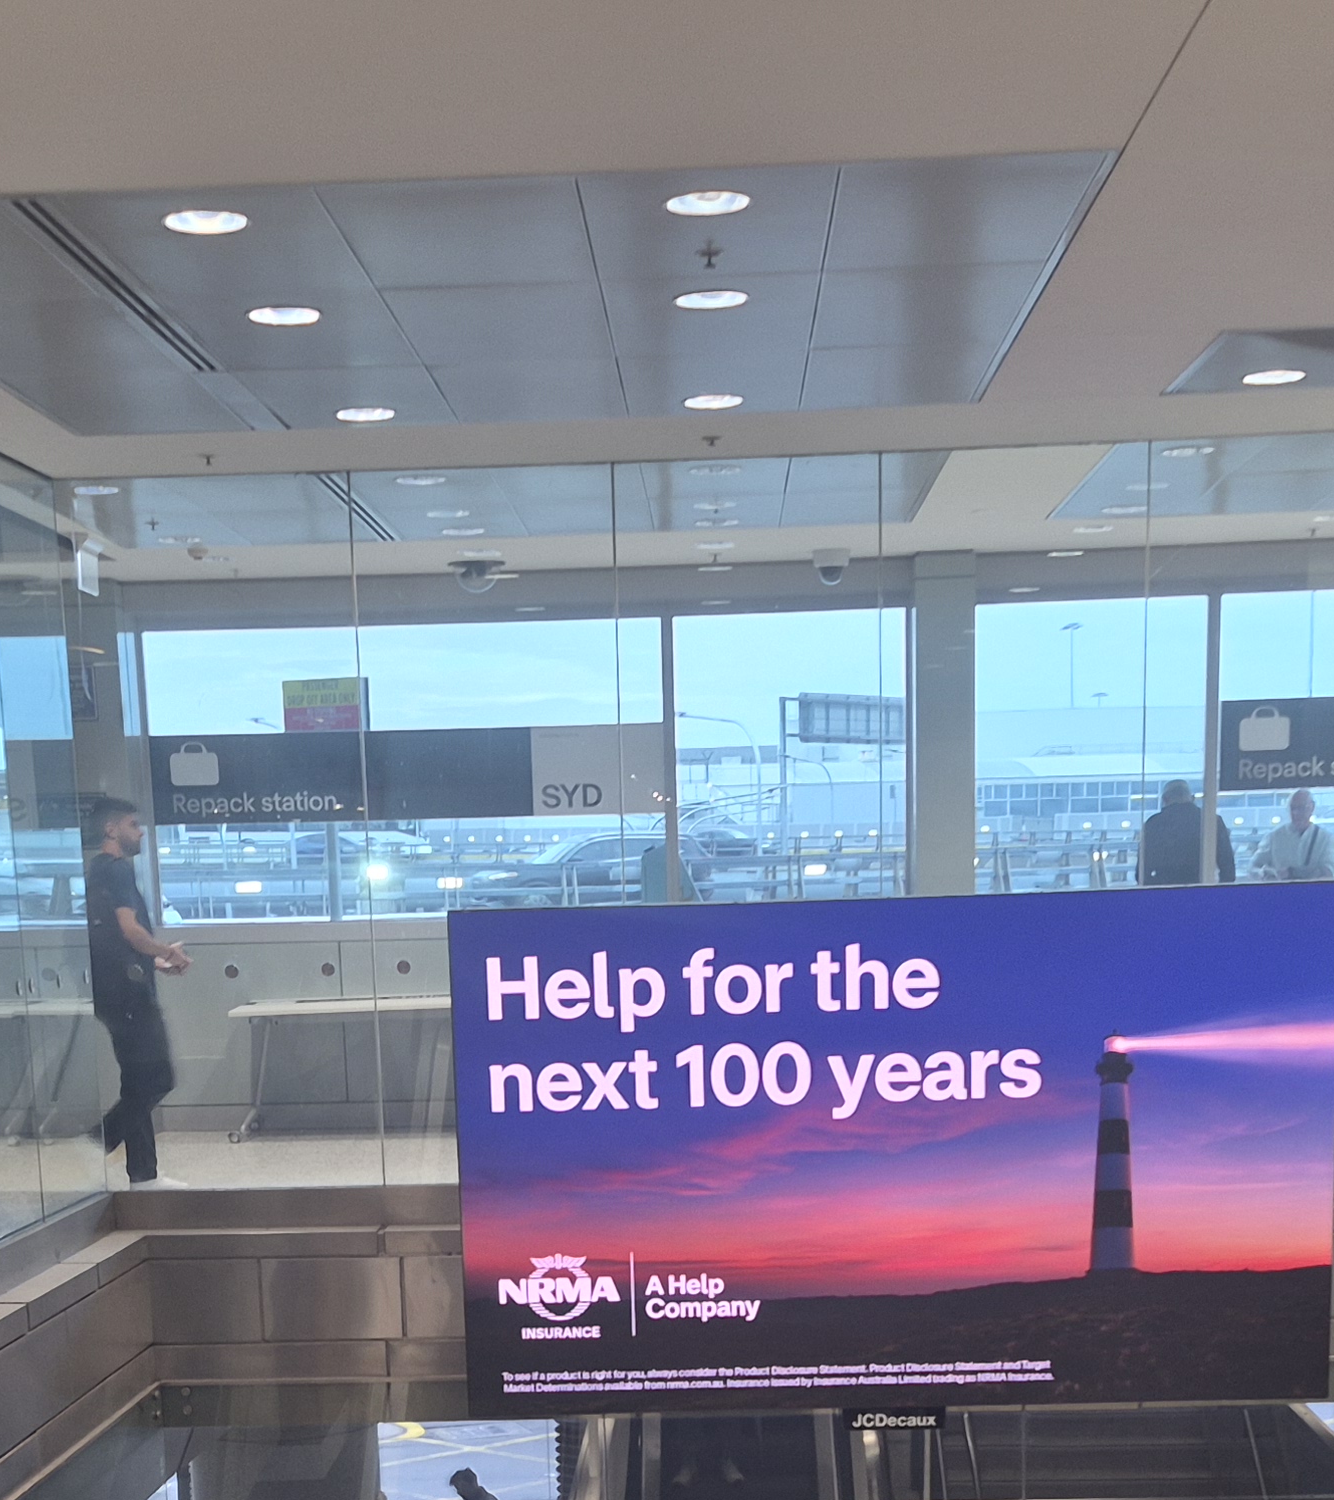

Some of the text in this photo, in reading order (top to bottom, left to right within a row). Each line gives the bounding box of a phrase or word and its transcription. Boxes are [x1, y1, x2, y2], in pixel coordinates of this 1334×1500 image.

[1238, 755, 1324, 783] Repack
[172, 790, 337, 817] Repack station
[541, 784, 603, 809] SYD
[485, 942, 941, 1033] Help for the
[488, 1040, 1043, 1120] next 100 years
[497, 1276, 621, 1305] NRMA
[644, 1273, 725, 1299] A Help
[644, 1298, 761, 1322] Company
[521, 1325, 601, 1340] INSURANCE
[502, 1372, 513, 1381] To
[547, 1371, 581, 1382] product
[591, 1370, 612, 1381] right
[614, 1370, 626, 1379] for
[627, 1371, 646, 1381] you,
[718, 1367, 733, 1376] the
[734, 1366, 770, 1376] Product
[869, 1363, 905, 1373] Product
[644, 1381, 665, 1390] from
[801, 1376, 813, 1388] by
[852, 1413, 936, 1428] JCDecaux
